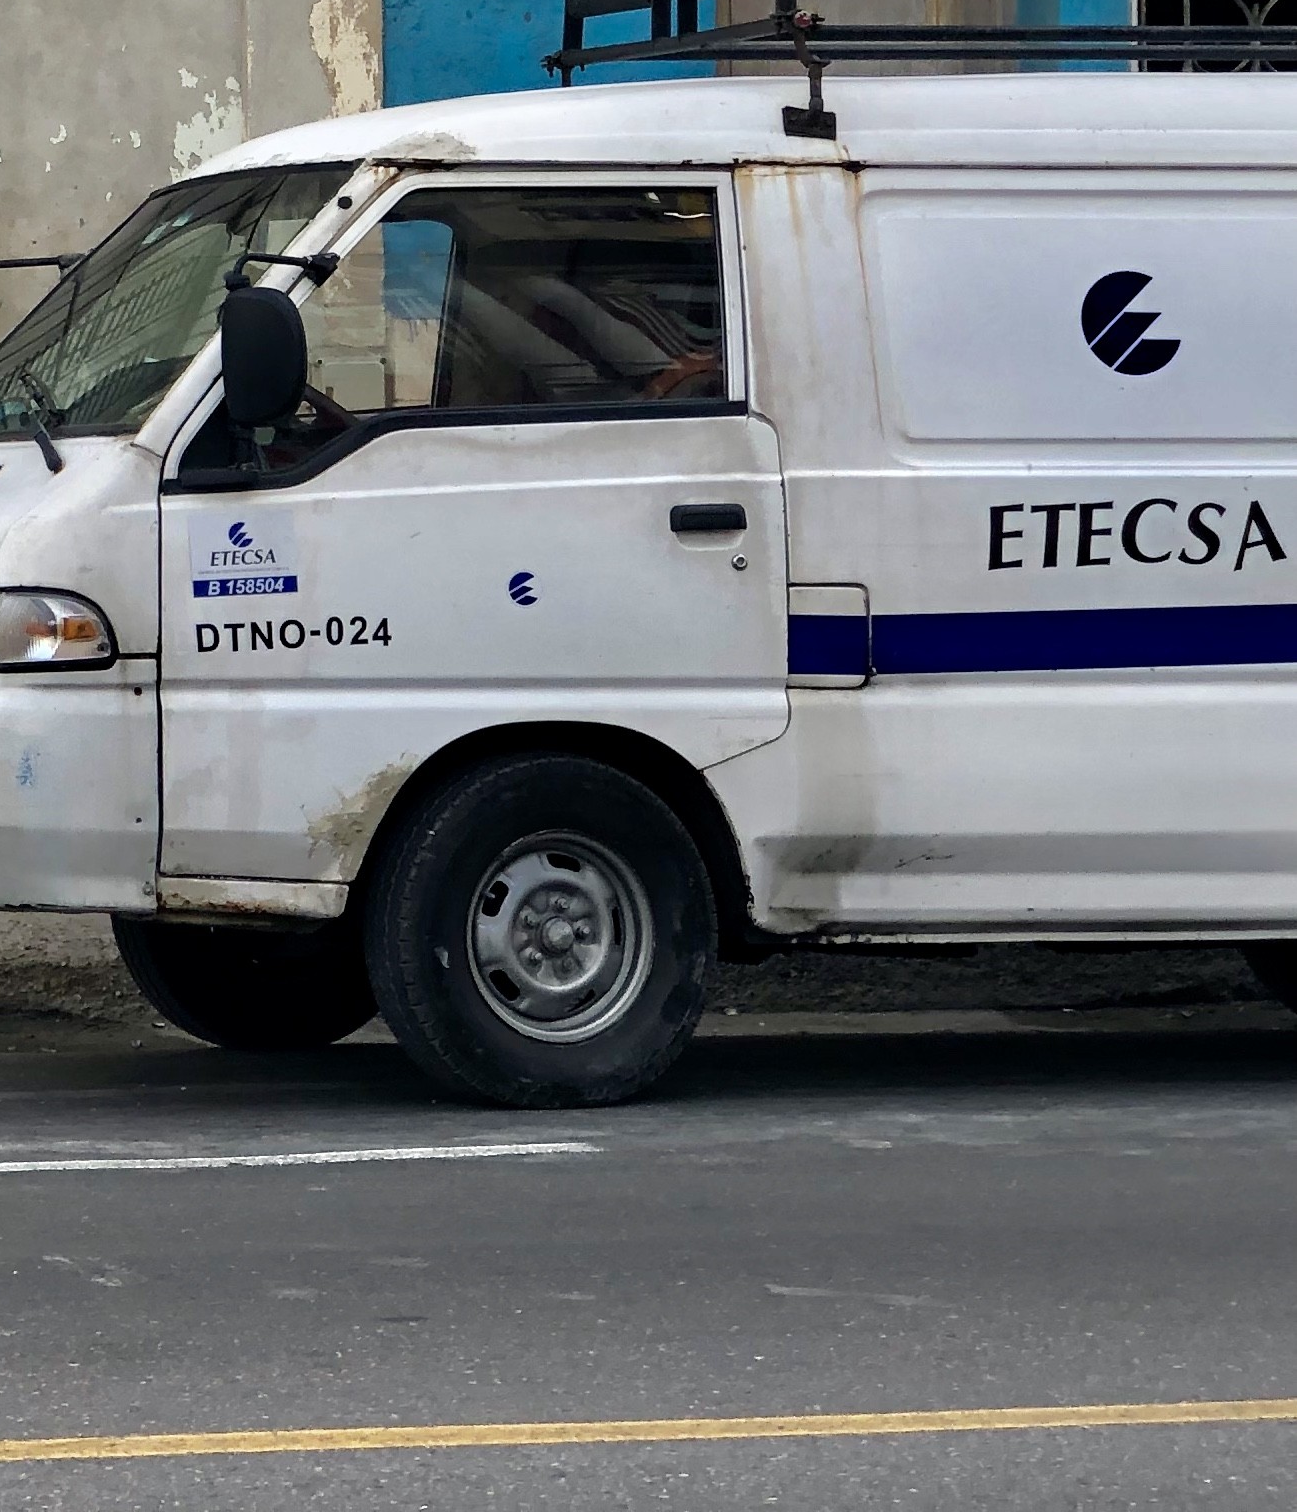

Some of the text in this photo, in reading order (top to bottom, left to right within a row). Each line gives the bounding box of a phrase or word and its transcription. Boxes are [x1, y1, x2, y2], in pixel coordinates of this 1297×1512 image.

[987, 497, 1287, 572] ETECSA
[210, 548, 276, 566] ETECSA
[207, 577, 285, 596] B 158504
[195, 615, 393, 653] DTNO-024
